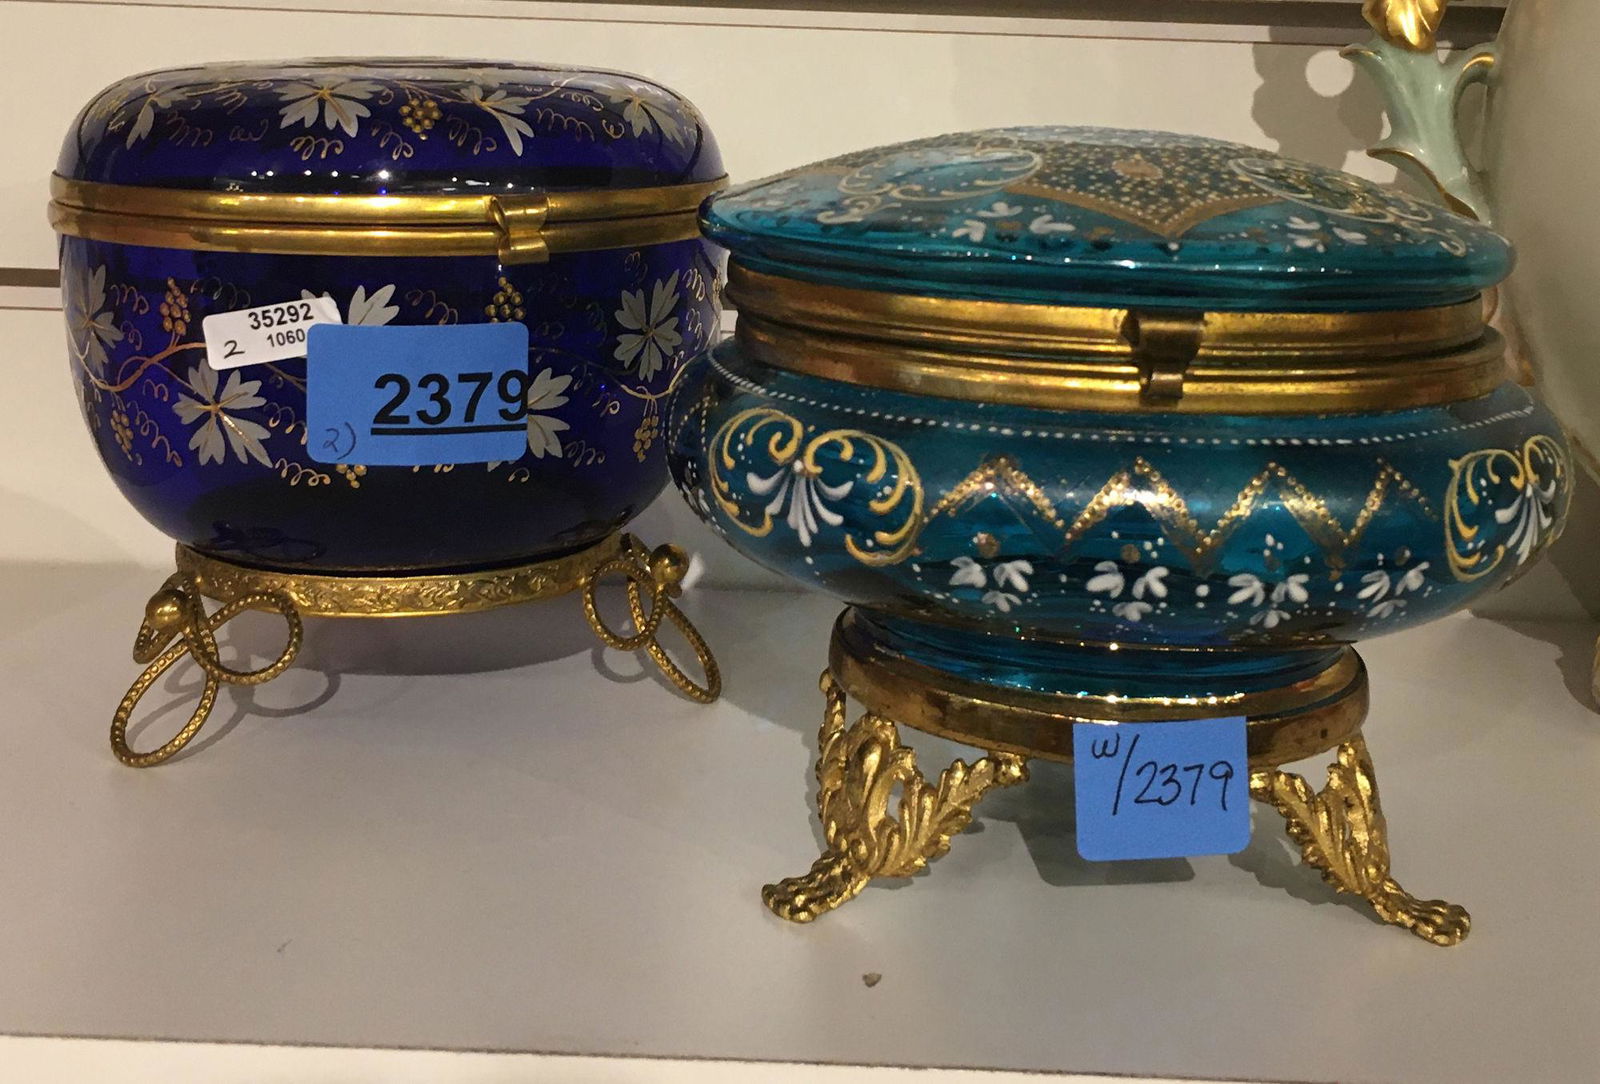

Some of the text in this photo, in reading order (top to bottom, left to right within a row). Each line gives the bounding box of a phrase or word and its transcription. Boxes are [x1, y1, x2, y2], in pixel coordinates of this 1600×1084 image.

[248, 303, 314, 330] 35292
[267, 328, 306, 347] 1060
[224, 340, 245, 359] 2
[372, 369, 529, 425] 2379
